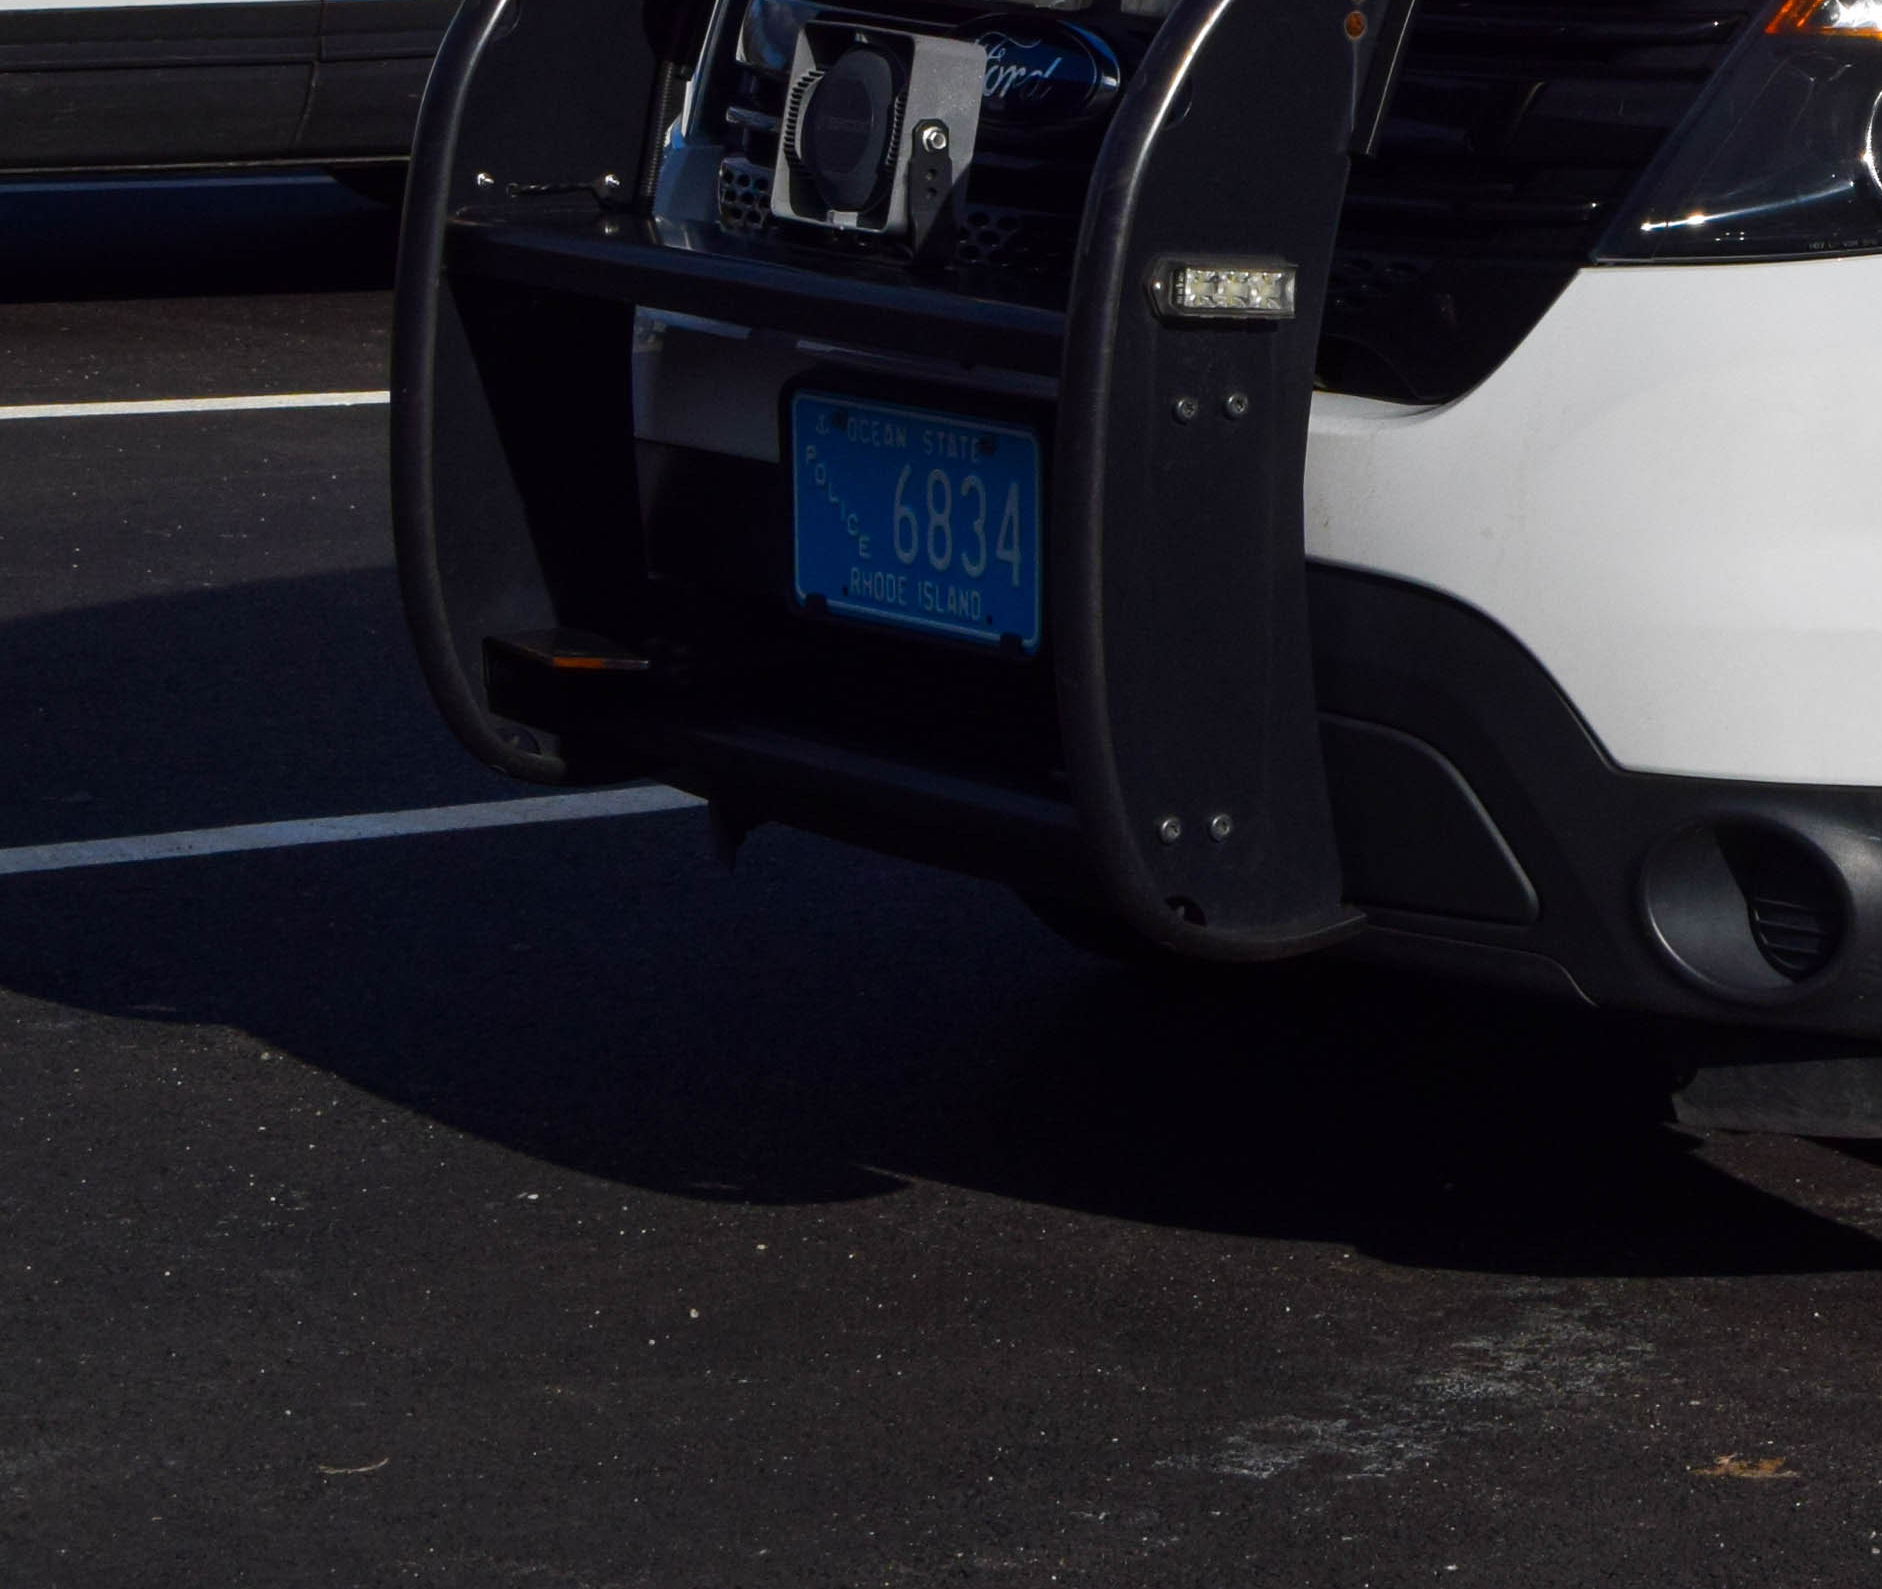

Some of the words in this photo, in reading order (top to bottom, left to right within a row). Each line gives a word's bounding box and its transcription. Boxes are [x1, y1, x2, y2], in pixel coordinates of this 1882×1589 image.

[847, 416, 908, 449] OCEAN
[922, 430, 982, 465] STATE
[892, 463, 1022, 588] 6834
[849, 566, 908, 608] RHODE
[917, 580, 982, 621] ISLAND
